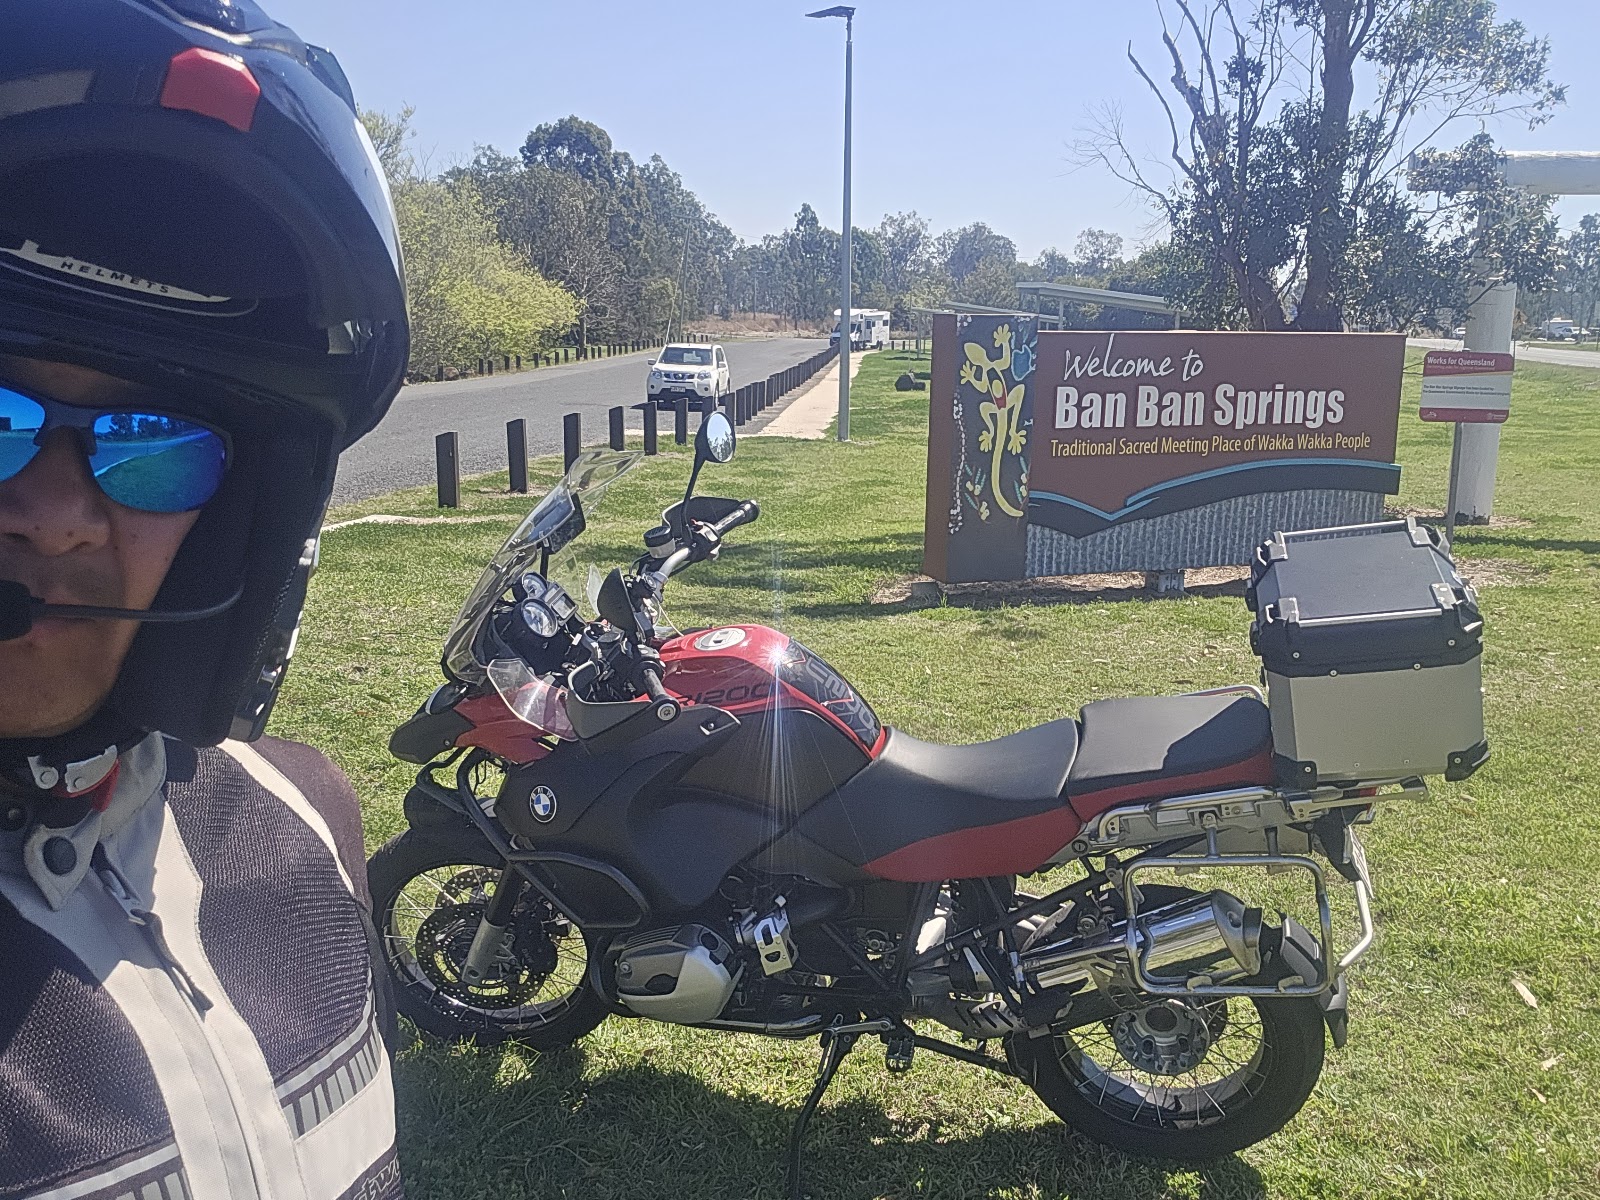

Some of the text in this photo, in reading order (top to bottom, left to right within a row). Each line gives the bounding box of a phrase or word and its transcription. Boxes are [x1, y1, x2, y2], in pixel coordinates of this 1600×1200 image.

[61, 260, 169, 294] HELMETS
[1063, 333, 1204, 382] Welcome to
[1427, 356, 1496, 367] Works for Queensland
[1055, 383, 1345, 430] Ban Ban Springs
[1051, 431, 1371, 457] Traditional Sacred Meeting Place of Wakka Wakka People
